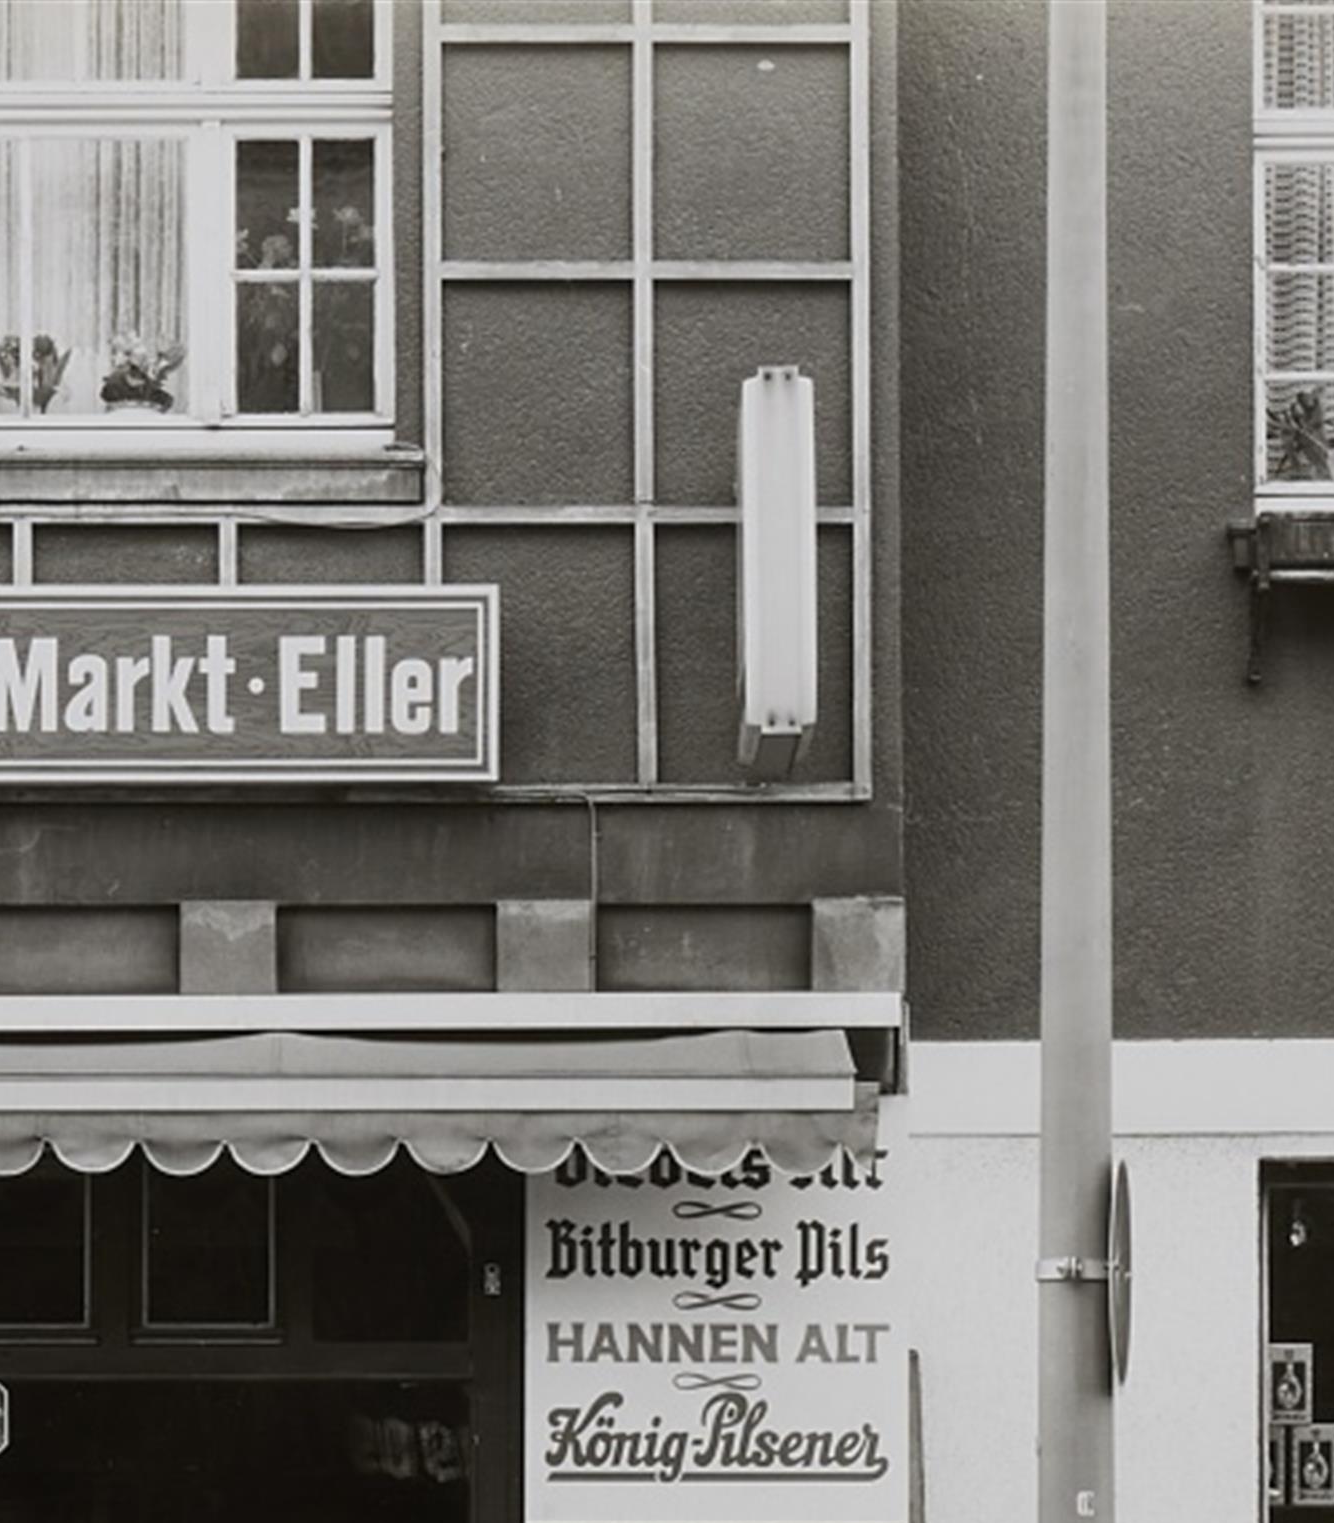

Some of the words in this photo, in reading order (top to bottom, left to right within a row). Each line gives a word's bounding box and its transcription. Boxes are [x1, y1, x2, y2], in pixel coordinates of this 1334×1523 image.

[278, 634, 475, 735] Eller
[544, 1218, 784, 1290] Bitburger
[793, 1218, 890, 1288] Pils
[545, 1321, 779, 1364] HANNEN
[794, 1322, 891, 1364] ALT
[543, 1391, 890, 1482] König-Pilsener
